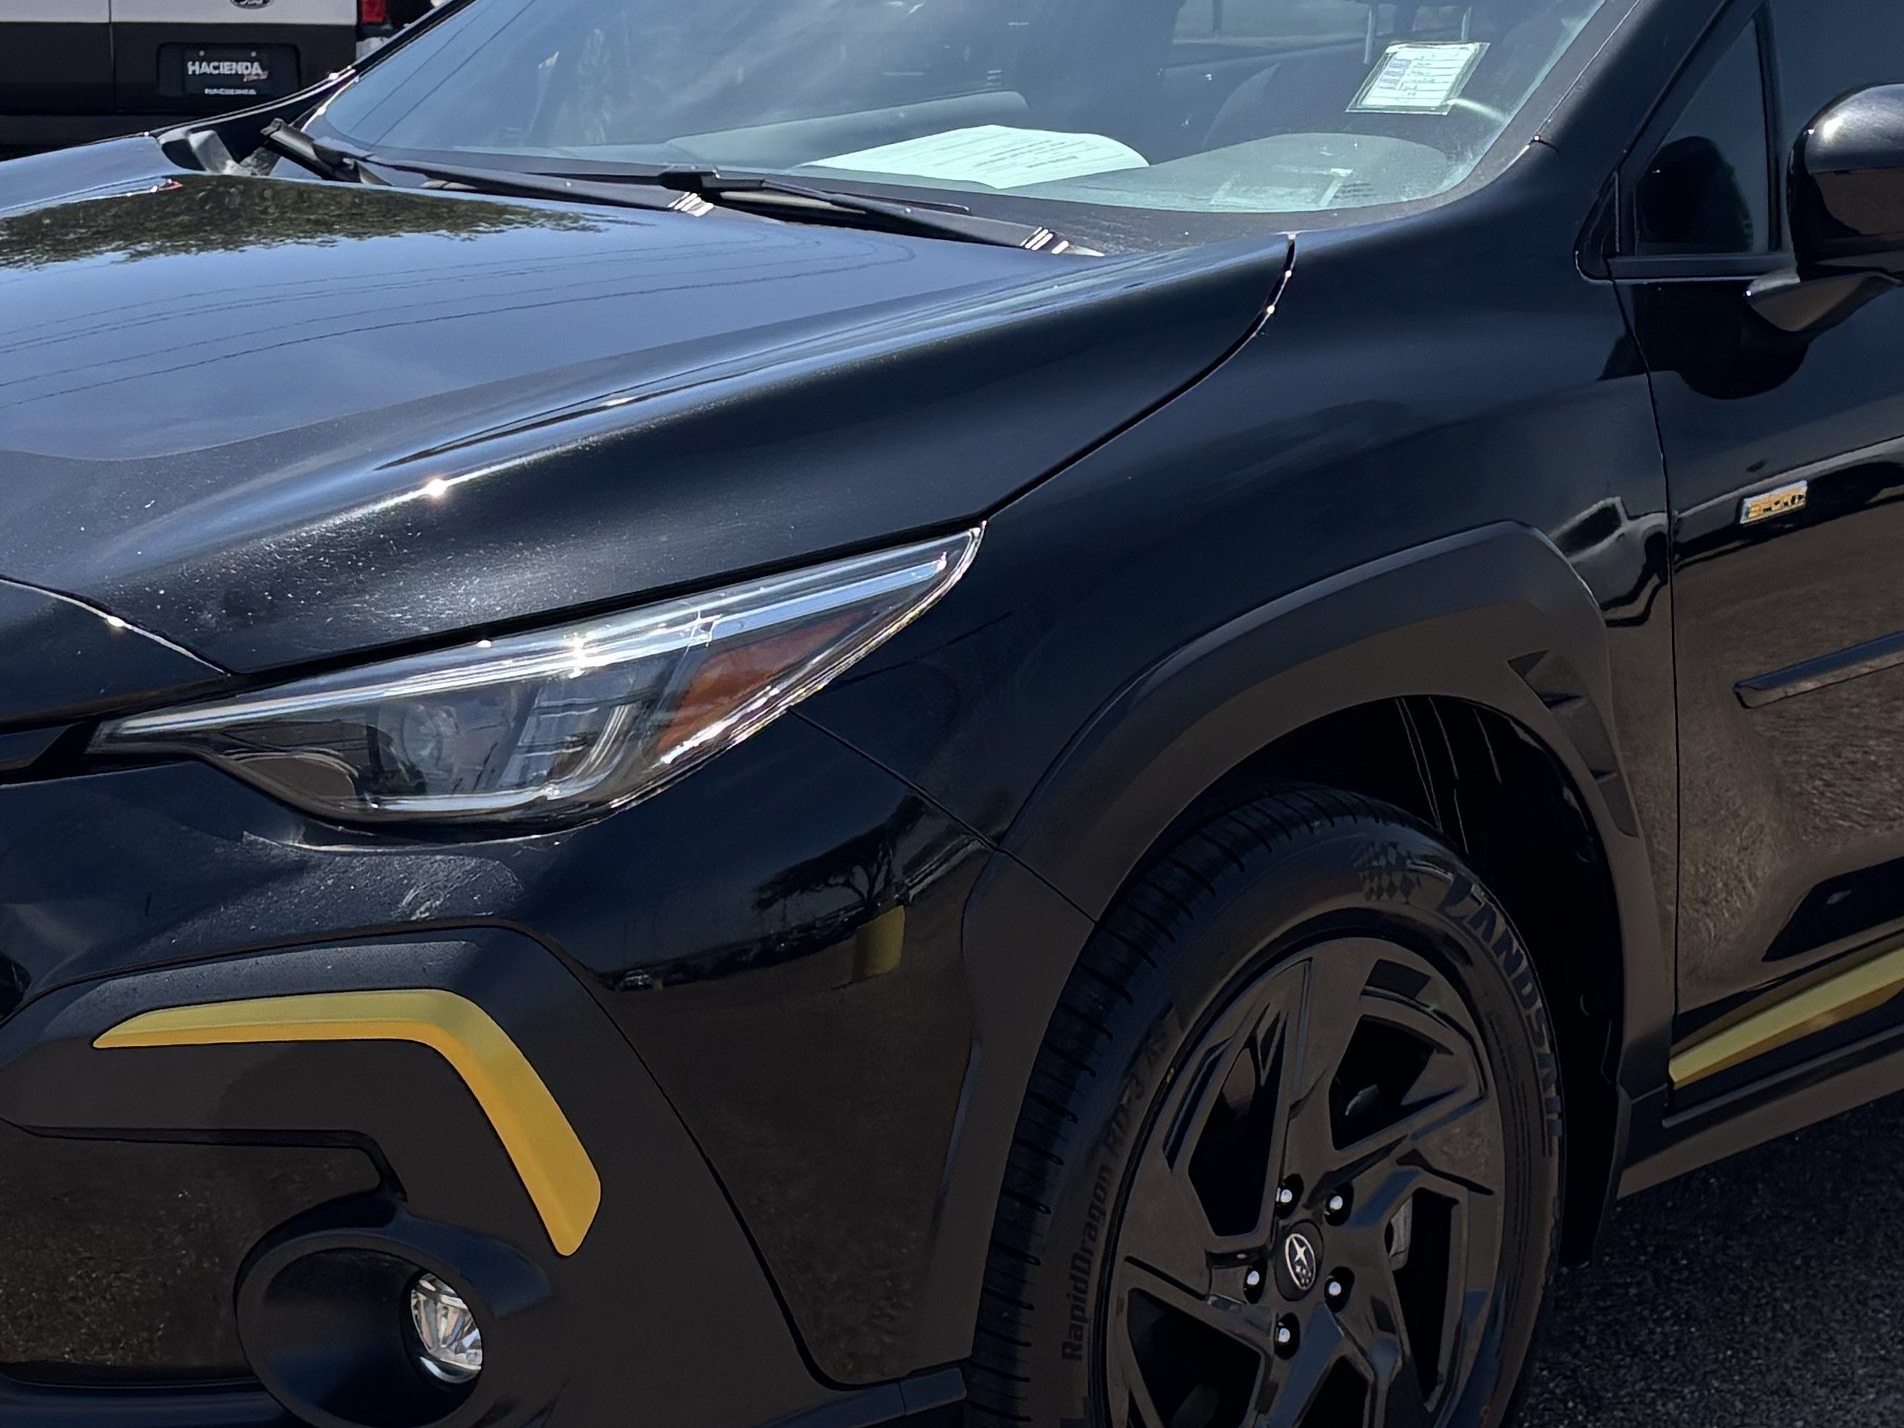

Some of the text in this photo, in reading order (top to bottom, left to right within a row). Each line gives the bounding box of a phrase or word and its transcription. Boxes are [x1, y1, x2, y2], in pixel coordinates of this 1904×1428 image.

[187, 61, 263, 75] HACIENDA
[1440, 870, 1565, 1137] LANDSAIL
[1062, 1161, 1114, 1362] RapidDragon
